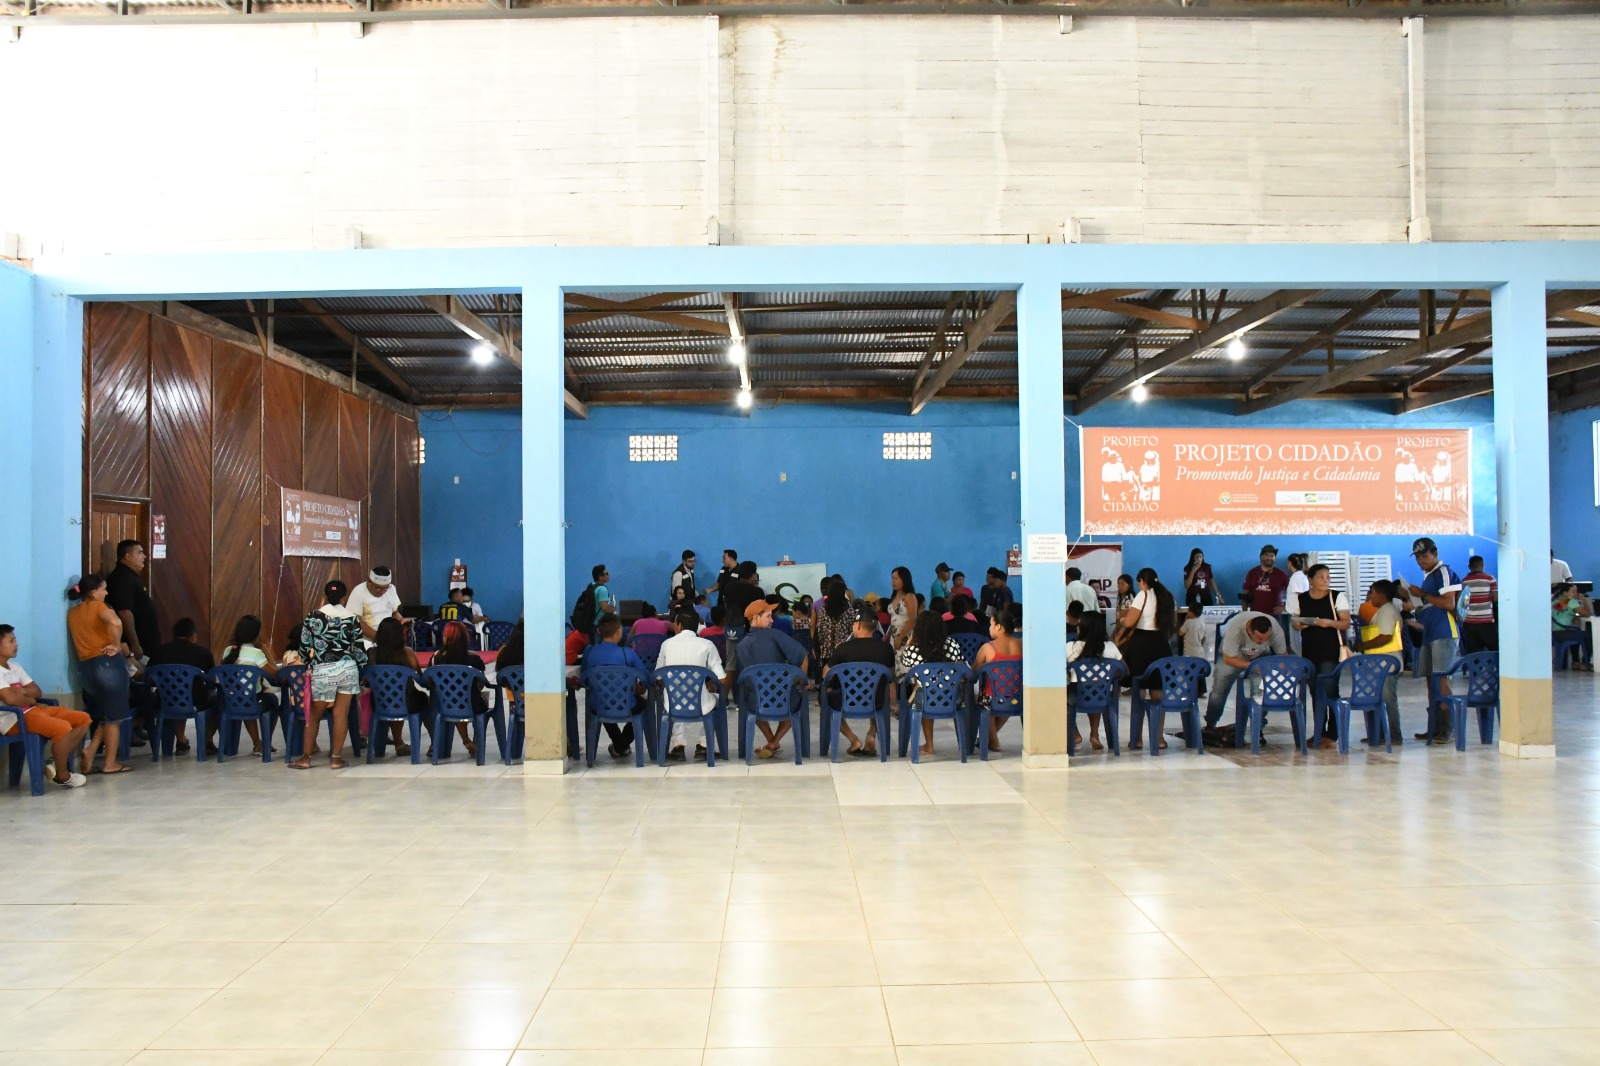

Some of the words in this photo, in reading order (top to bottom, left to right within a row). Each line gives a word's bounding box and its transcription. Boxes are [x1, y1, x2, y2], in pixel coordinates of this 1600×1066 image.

[1103, 436, 1159, 448] PROJETO
[1397, 437, 1451, 448] PROJETO
[1174, 444, 1273, 466] PROJETO
[1278, 442, 1382, 461] CIDADÃO
[1175, 465, 1253, 481] Promovendo
[1254, 466, 1299, 485] Justiça
[1303, 471, 1310, 481] e
[1313, 465, 1381, 481] Cidadania
[303, 501, 324, 515] PROJETO
[1103, 500, 1159, 512] CIDADÃO
[1396, 500, 1451, 512] CIDADÃO
[441, 607, 458, 620] 10
